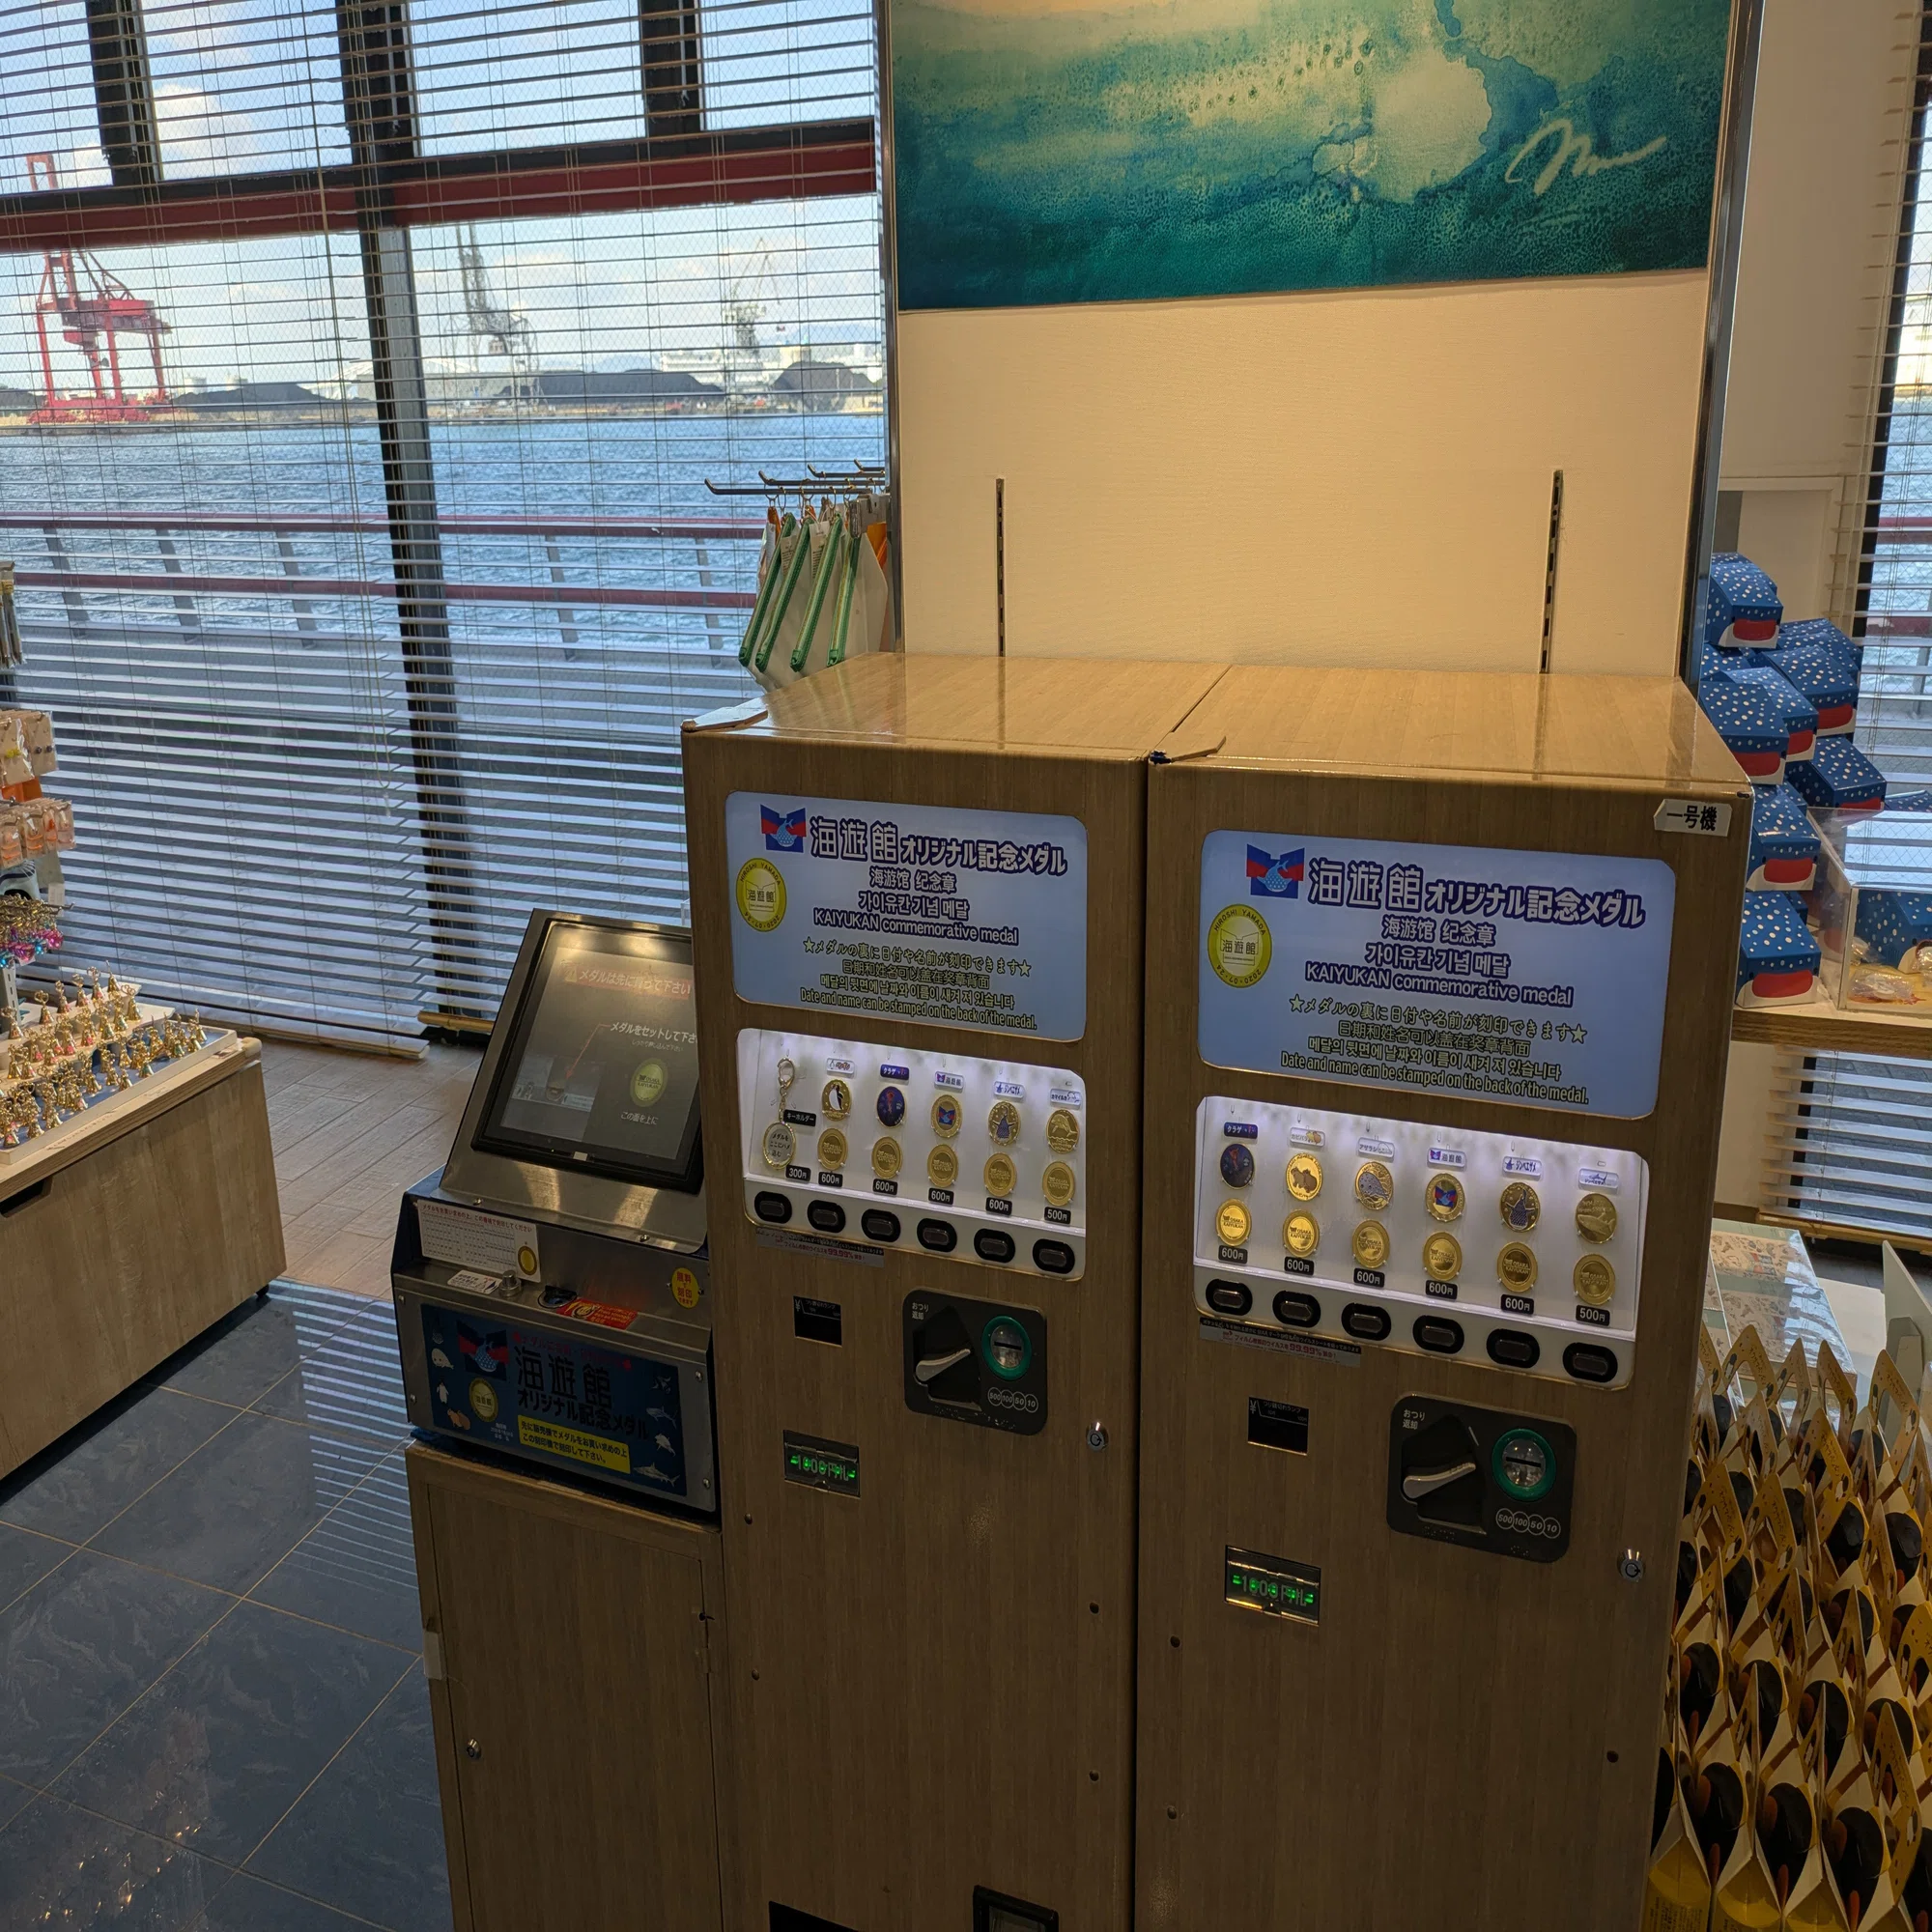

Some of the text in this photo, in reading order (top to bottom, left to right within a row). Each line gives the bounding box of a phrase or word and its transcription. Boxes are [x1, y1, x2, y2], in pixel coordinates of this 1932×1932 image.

[1666, 805, 1718, 832] 一号機
[740, 863, 781, 885] HIROSHI YAMADA
[869, 867, 956, 894] 海游馆 纪念章
[859, 891, 970, 921] 가이유칸 기념 메달
[814, 908, 1019, 947] KAIYUKAN commemorative medal
[1213, 909, 1266, 935] HIROSHI YAMADA
[1382, 915, 1496, 948] 海游馆 纪念章
[1223, 939, 1256, 954] 海遊館
[1364, 942, 1512, 979] 가이유칸 기념 메달
[820, 974, 848, 990] 메달의
[909, 983, 940, 1001] 이름이
[974, 991, 1015, 1010] 있습니다
[1305, 961, 1575, 1008] KAIYUKAN commemorative medal
[801, 987, 1037, 1031] Date and name can be stamped on the back of the medal.
[610, 1021, 697, 1044] メダルをセットして下さ
[1308, 1037, 1344, 1056] 메달의
[1424, 1050, 1463, 1069] 이름이
[1507, 1058, 1562, 1082] 있습니다
[1281, 1050, 1590, 1105] Date and name can be stamped on the back of the medal.
[787, 1113, 814, 1122] キーホルダー
[788, 1167, 807, 1179] 300円
[821, 1173, 839, 1184] 600円
[875, 1180, 895, 1192] 600円
[930, 1190, 951, 1203] 600円
[988, 1200, 1009, 1212] 600円
[1047, 1209, 1067, 1222] 500円
[1221, 1247, 1244, 1261] 600円
[1287, 1259, 1310, 1272] 600円
[1356, 1271, 1380, 1285] 600円
[1429, 1282, 1453, 1295] 600円
[912, 1302, 929, 1312] おつり
[1505, 1297, 1530, 1312] 600円
[1579, 1307, 1605, 1322] 500円
[514, 1346, 612, 1408] 海遊館
[989, 1392, 1037, 1408] 500 100 50 10
[1250, 1400, 1257, 1414] ¥
[518, 1388, 650, 1440] オリジナル記念メダル
[1403, 1409, 1426, 1420] おつり
[1497, 1514, 1557, 1533] 500 100 50 10
